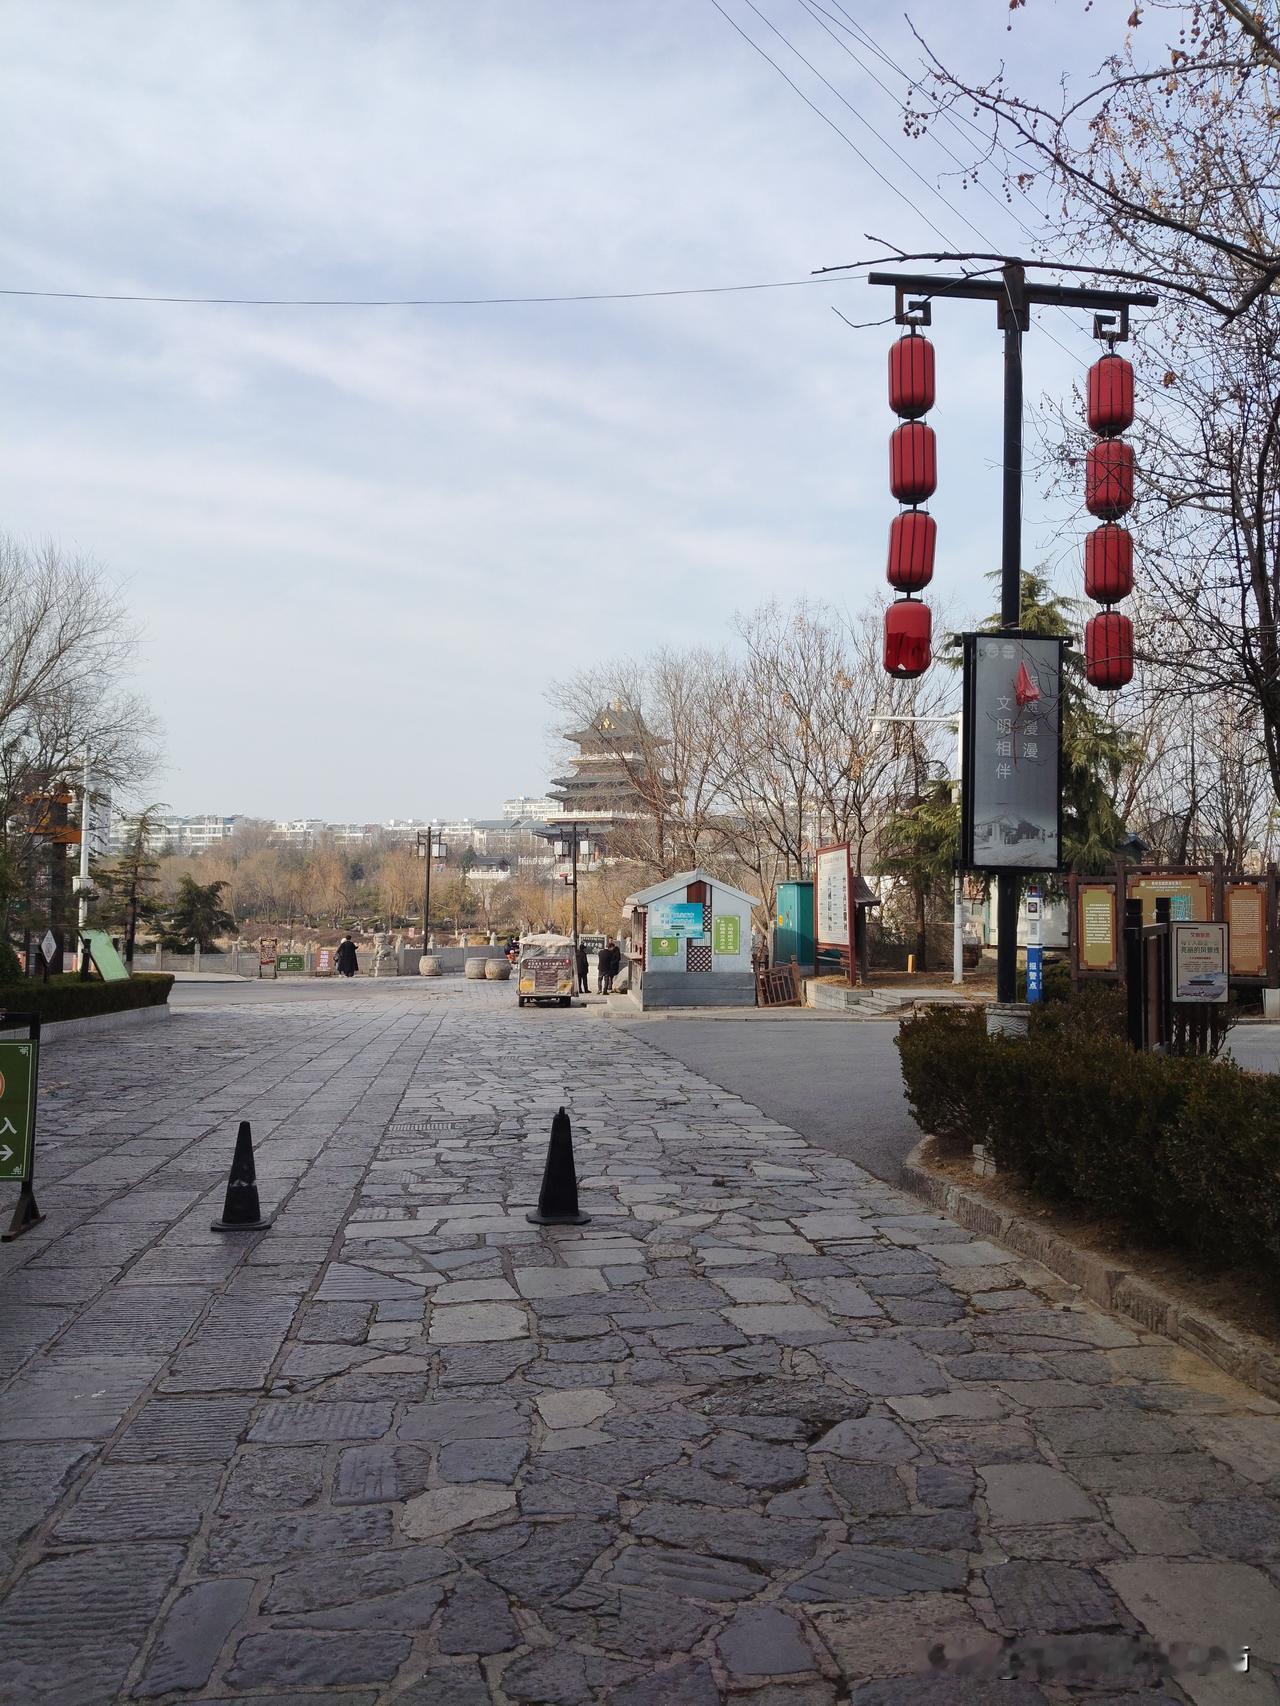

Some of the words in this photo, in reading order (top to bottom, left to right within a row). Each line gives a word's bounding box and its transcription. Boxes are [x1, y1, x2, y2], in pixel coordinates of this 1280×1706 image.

[995, 695, 1012, 780] 文明相伴
[1028, 962, 1038, 990] 报警点
